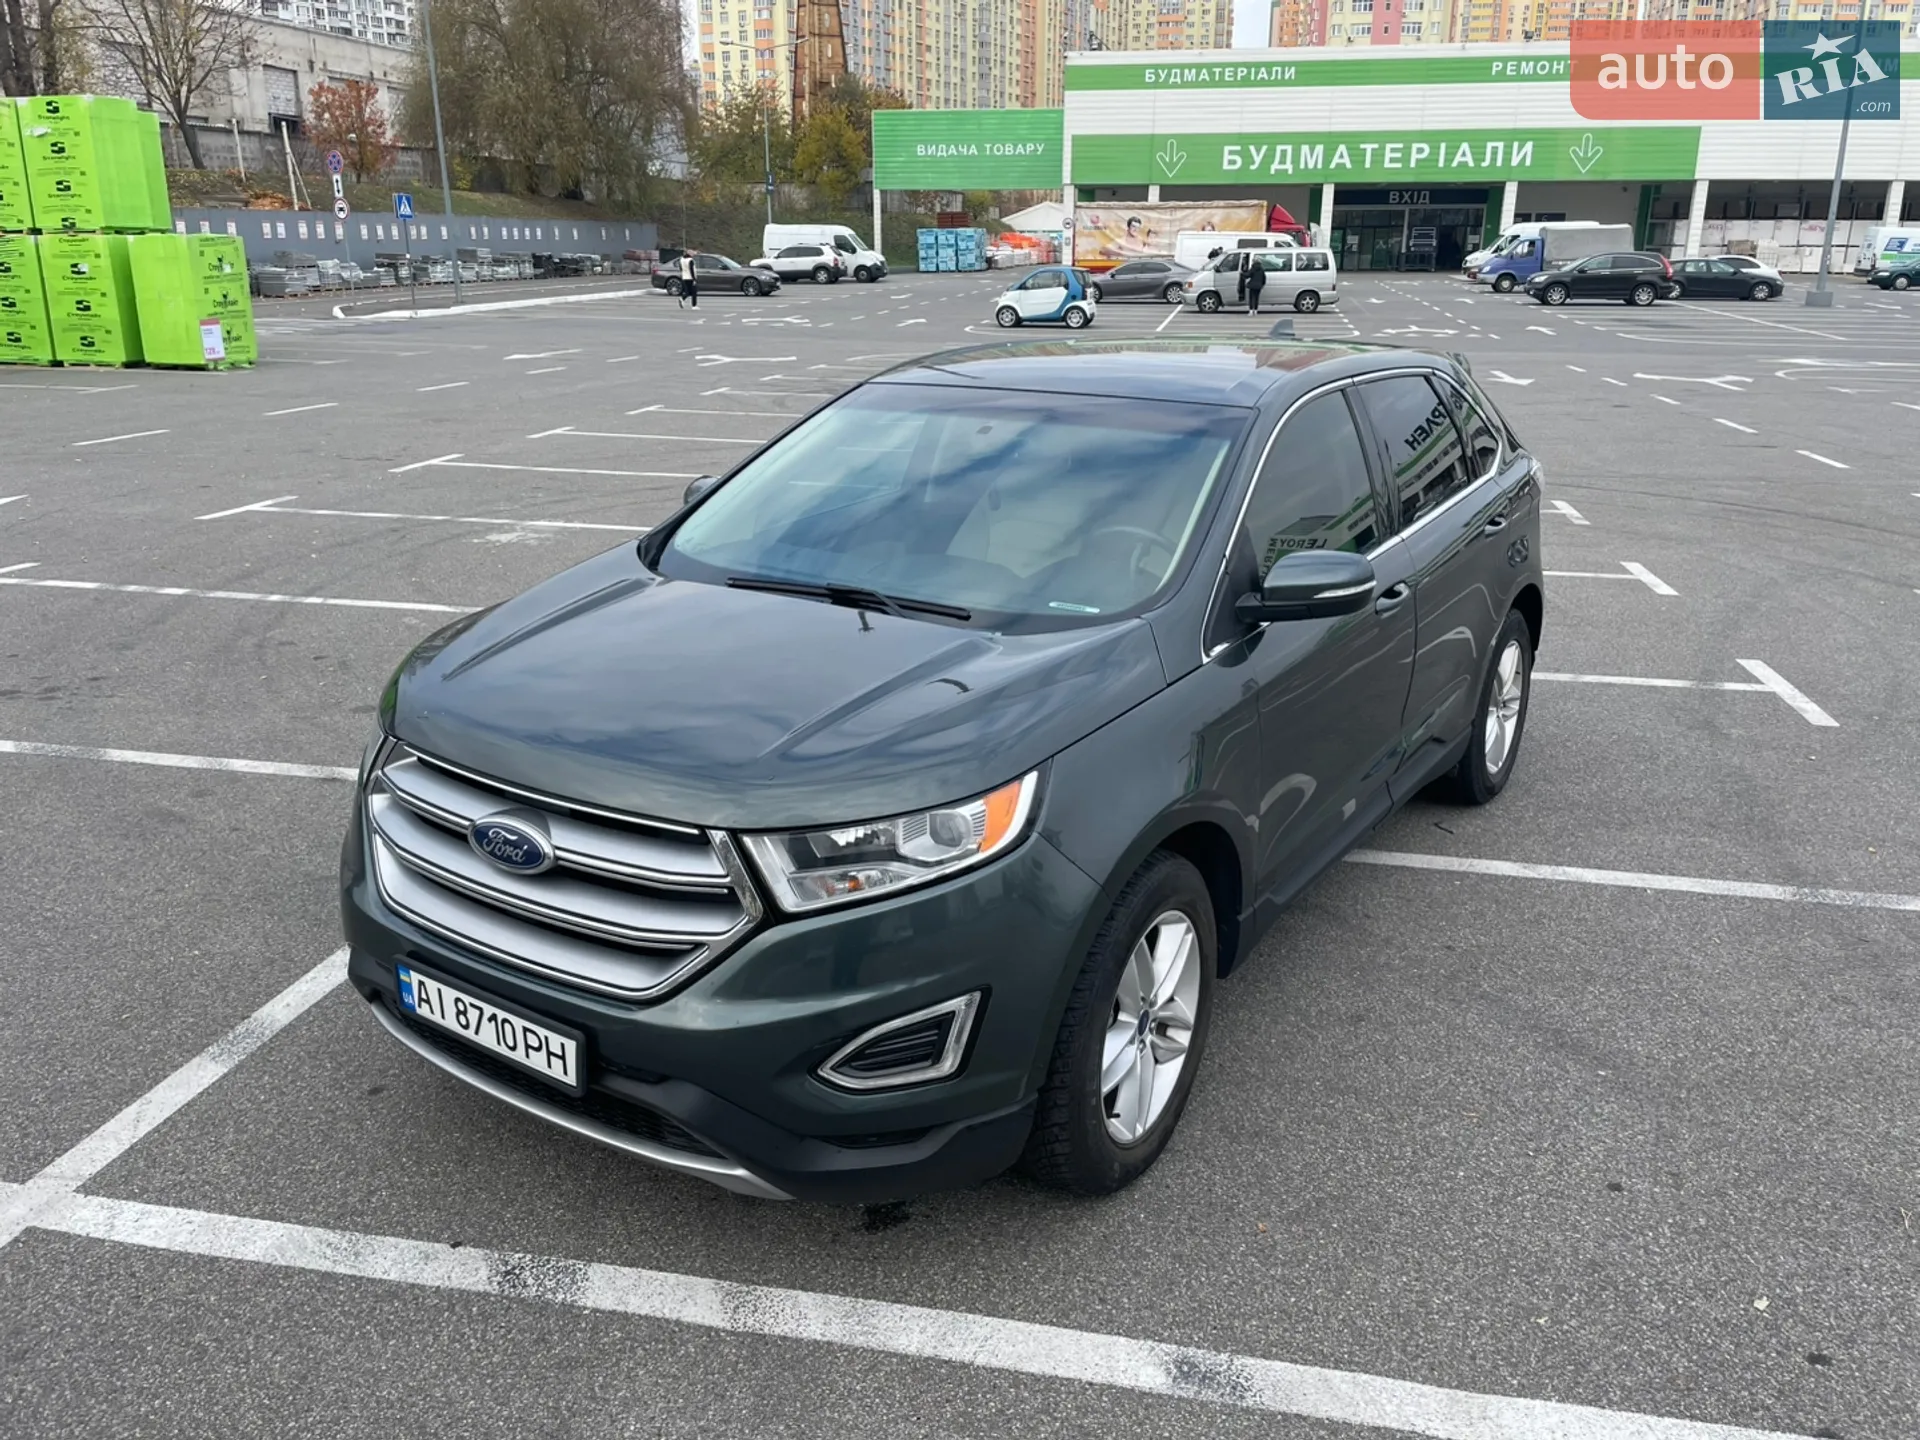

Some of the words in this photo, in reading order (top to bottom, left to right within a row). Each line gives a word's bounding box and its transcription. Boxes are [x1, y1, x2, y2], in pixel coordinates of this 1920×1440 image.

[1144, 66, 1297, 84] БУДМАТЕРІАЛИ
[916, 144, 980, 158] ВИДАЧА
[984, 142, 1045, 156] ТОВАРУ
[1222, 141, 1534, 175] БУДМАТЕРІАЛИ
[1389, 190, 1430, 204] ВХІД
[483, 827, 528, 864] Ford
[402, 991, 415, 1006] UA
[417, 979, 446, 1021] AI
[454, 996, 518, 1053] 8710
[522, 1025, 568, 1077] PH
